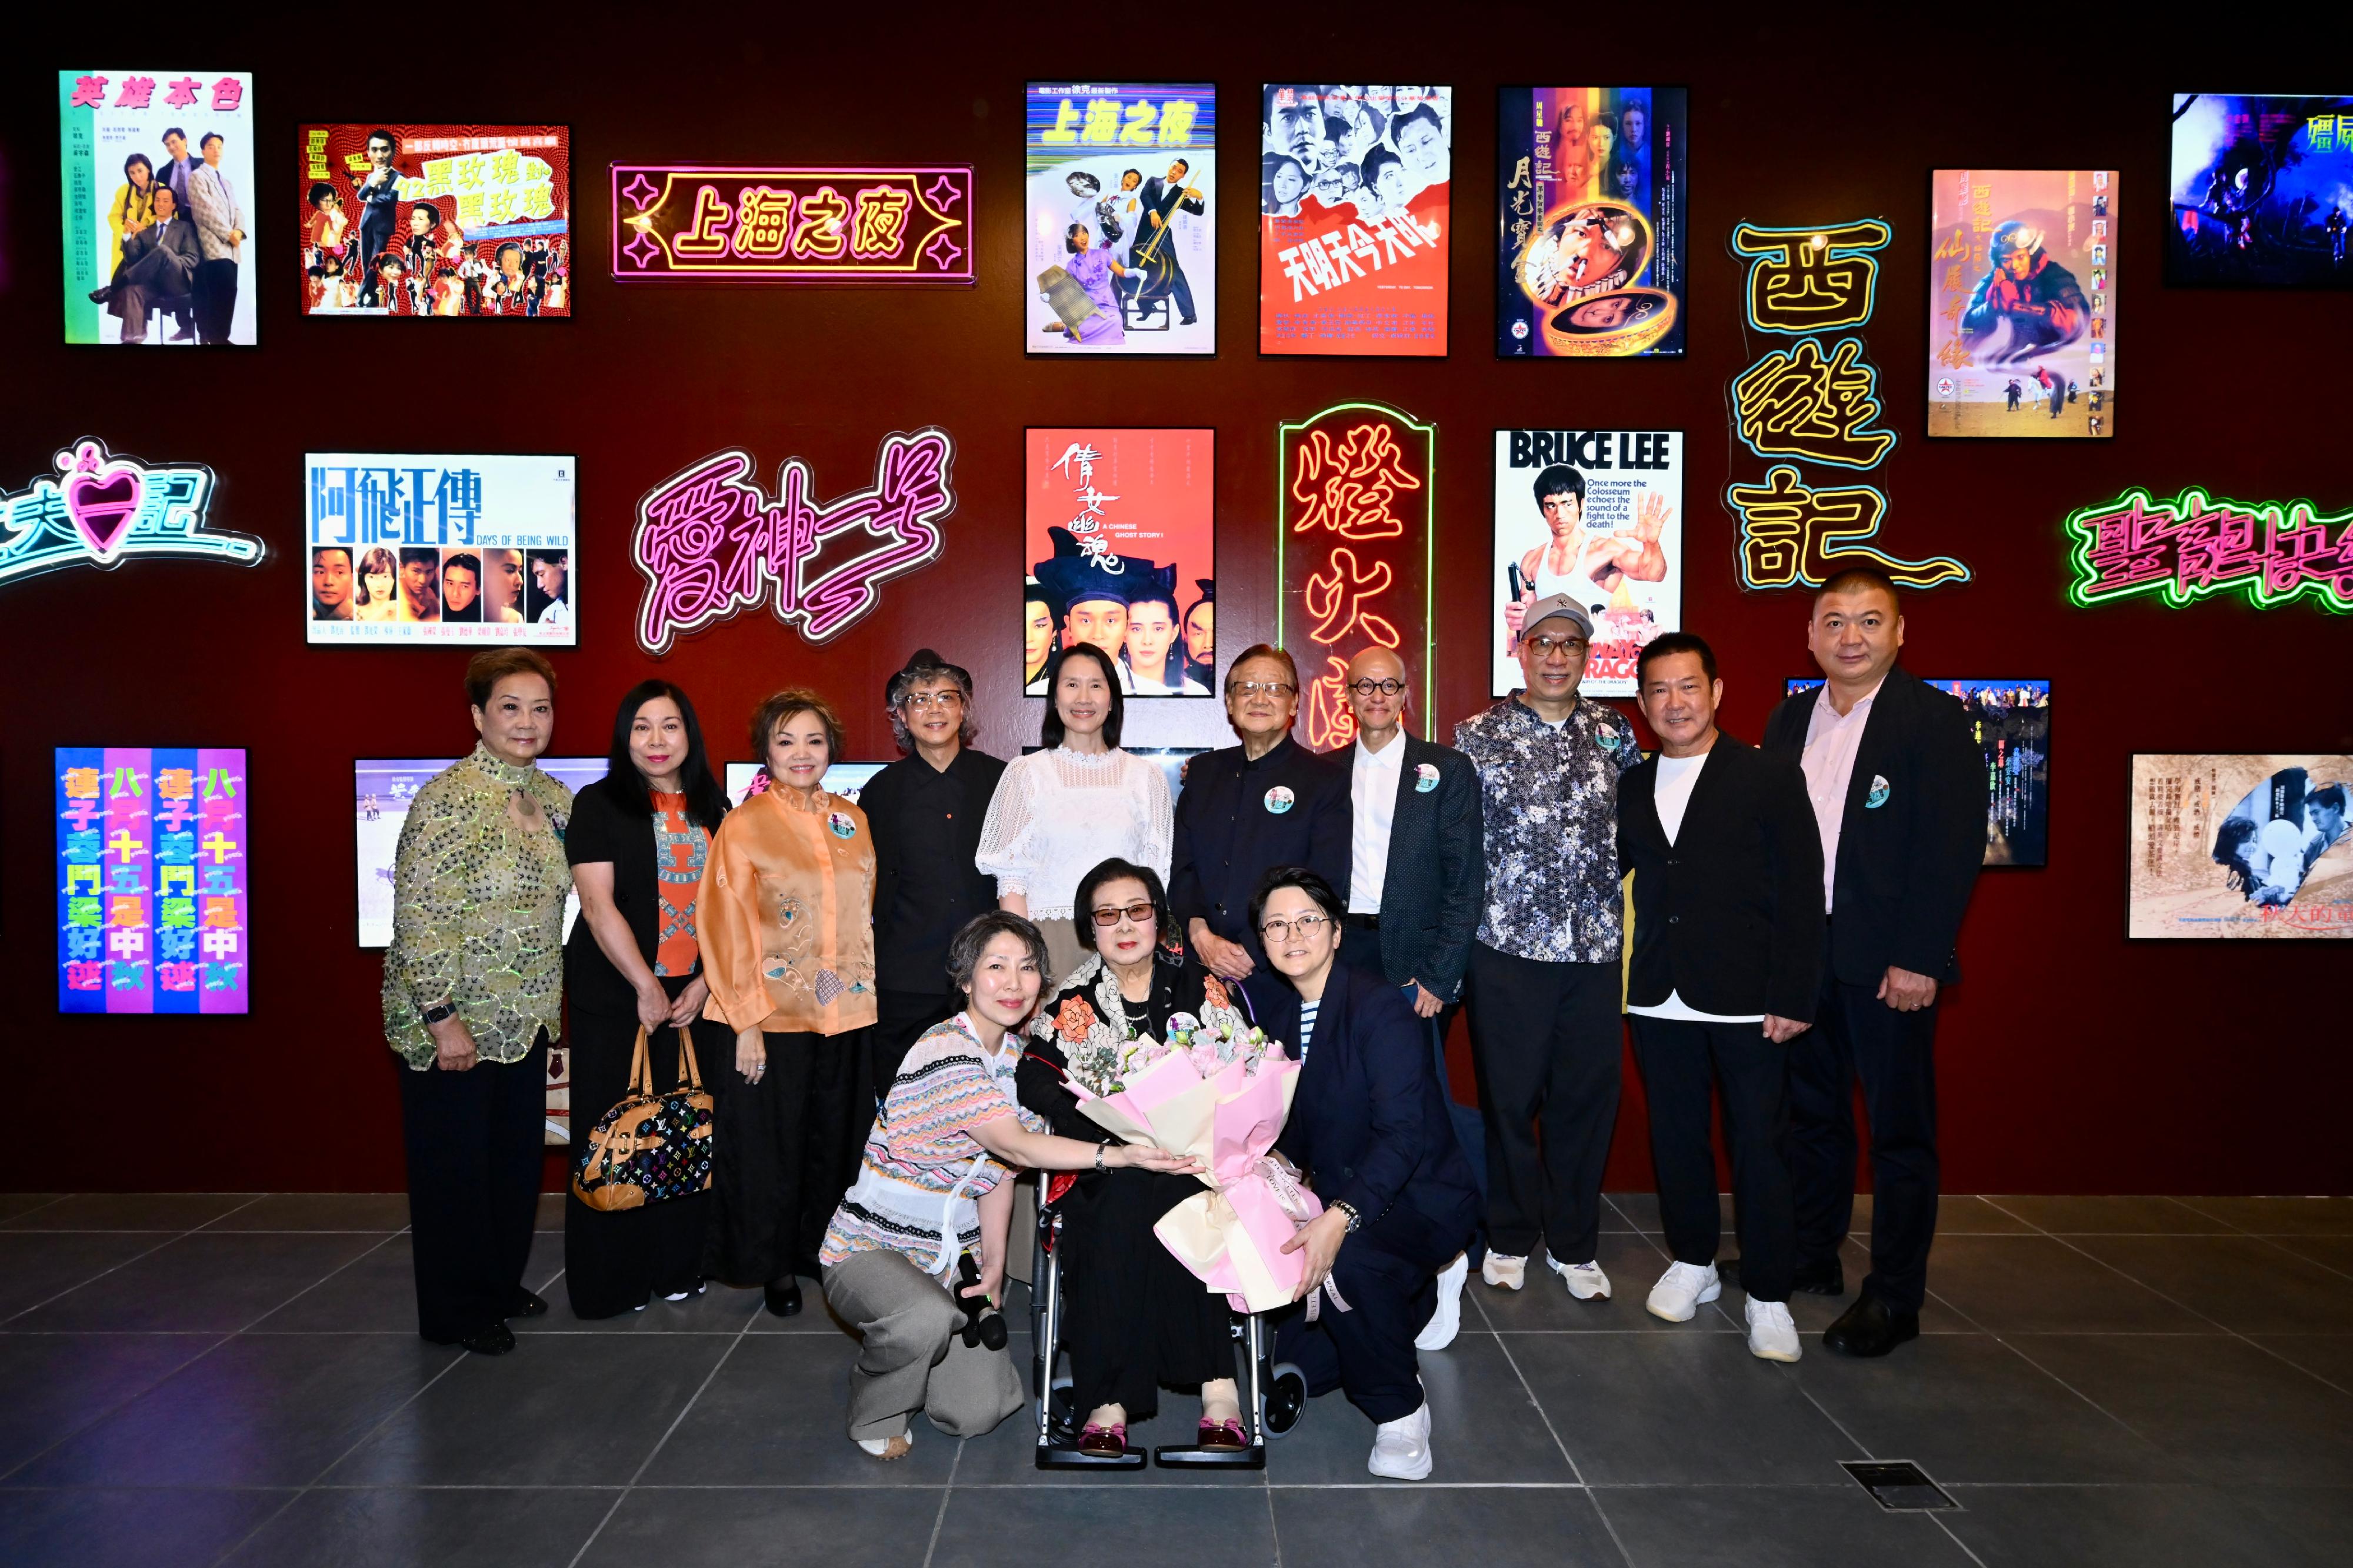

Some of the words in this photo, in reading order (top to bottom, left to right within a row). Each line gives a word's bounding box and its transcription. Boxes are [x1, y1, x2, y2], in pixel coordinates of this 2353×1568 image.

[70, 75, 244, 111] 英雄本色
[1042, 98, 1198, 145] 上海之夜
[673, 185, 913, 260] 上海之夜
[1507, 156, 1537, 283] 月光寶盒
[1728, 218, 1971, 589] 西遊記
[1509, 431, 1612, 469] BRUCE
[1619, 432, 1669, 470] LEE
[1587, 479, 1609, 488] Once
[1633, 479, 1647, 488] the
[311, 467, 482, 545] 阿飛正傳
[1051, 442, 1125, 575] 倩女幽魂
[1587, 487, 1630, 495] Colosseum
[1587, 512, 1605, 521] fight
[476, 535, 498, 546] DAYS
[501, 535, 512, 546] OF
[516, 536, 542, 546] BEING
[546, 536, 569, 546] WILD
[2074, 491, 2353, 606] 聖誕快
[109, 767, 145, 991] 八月十五是中秋
[202, 768, 239, 991] 八月十五是中秋
